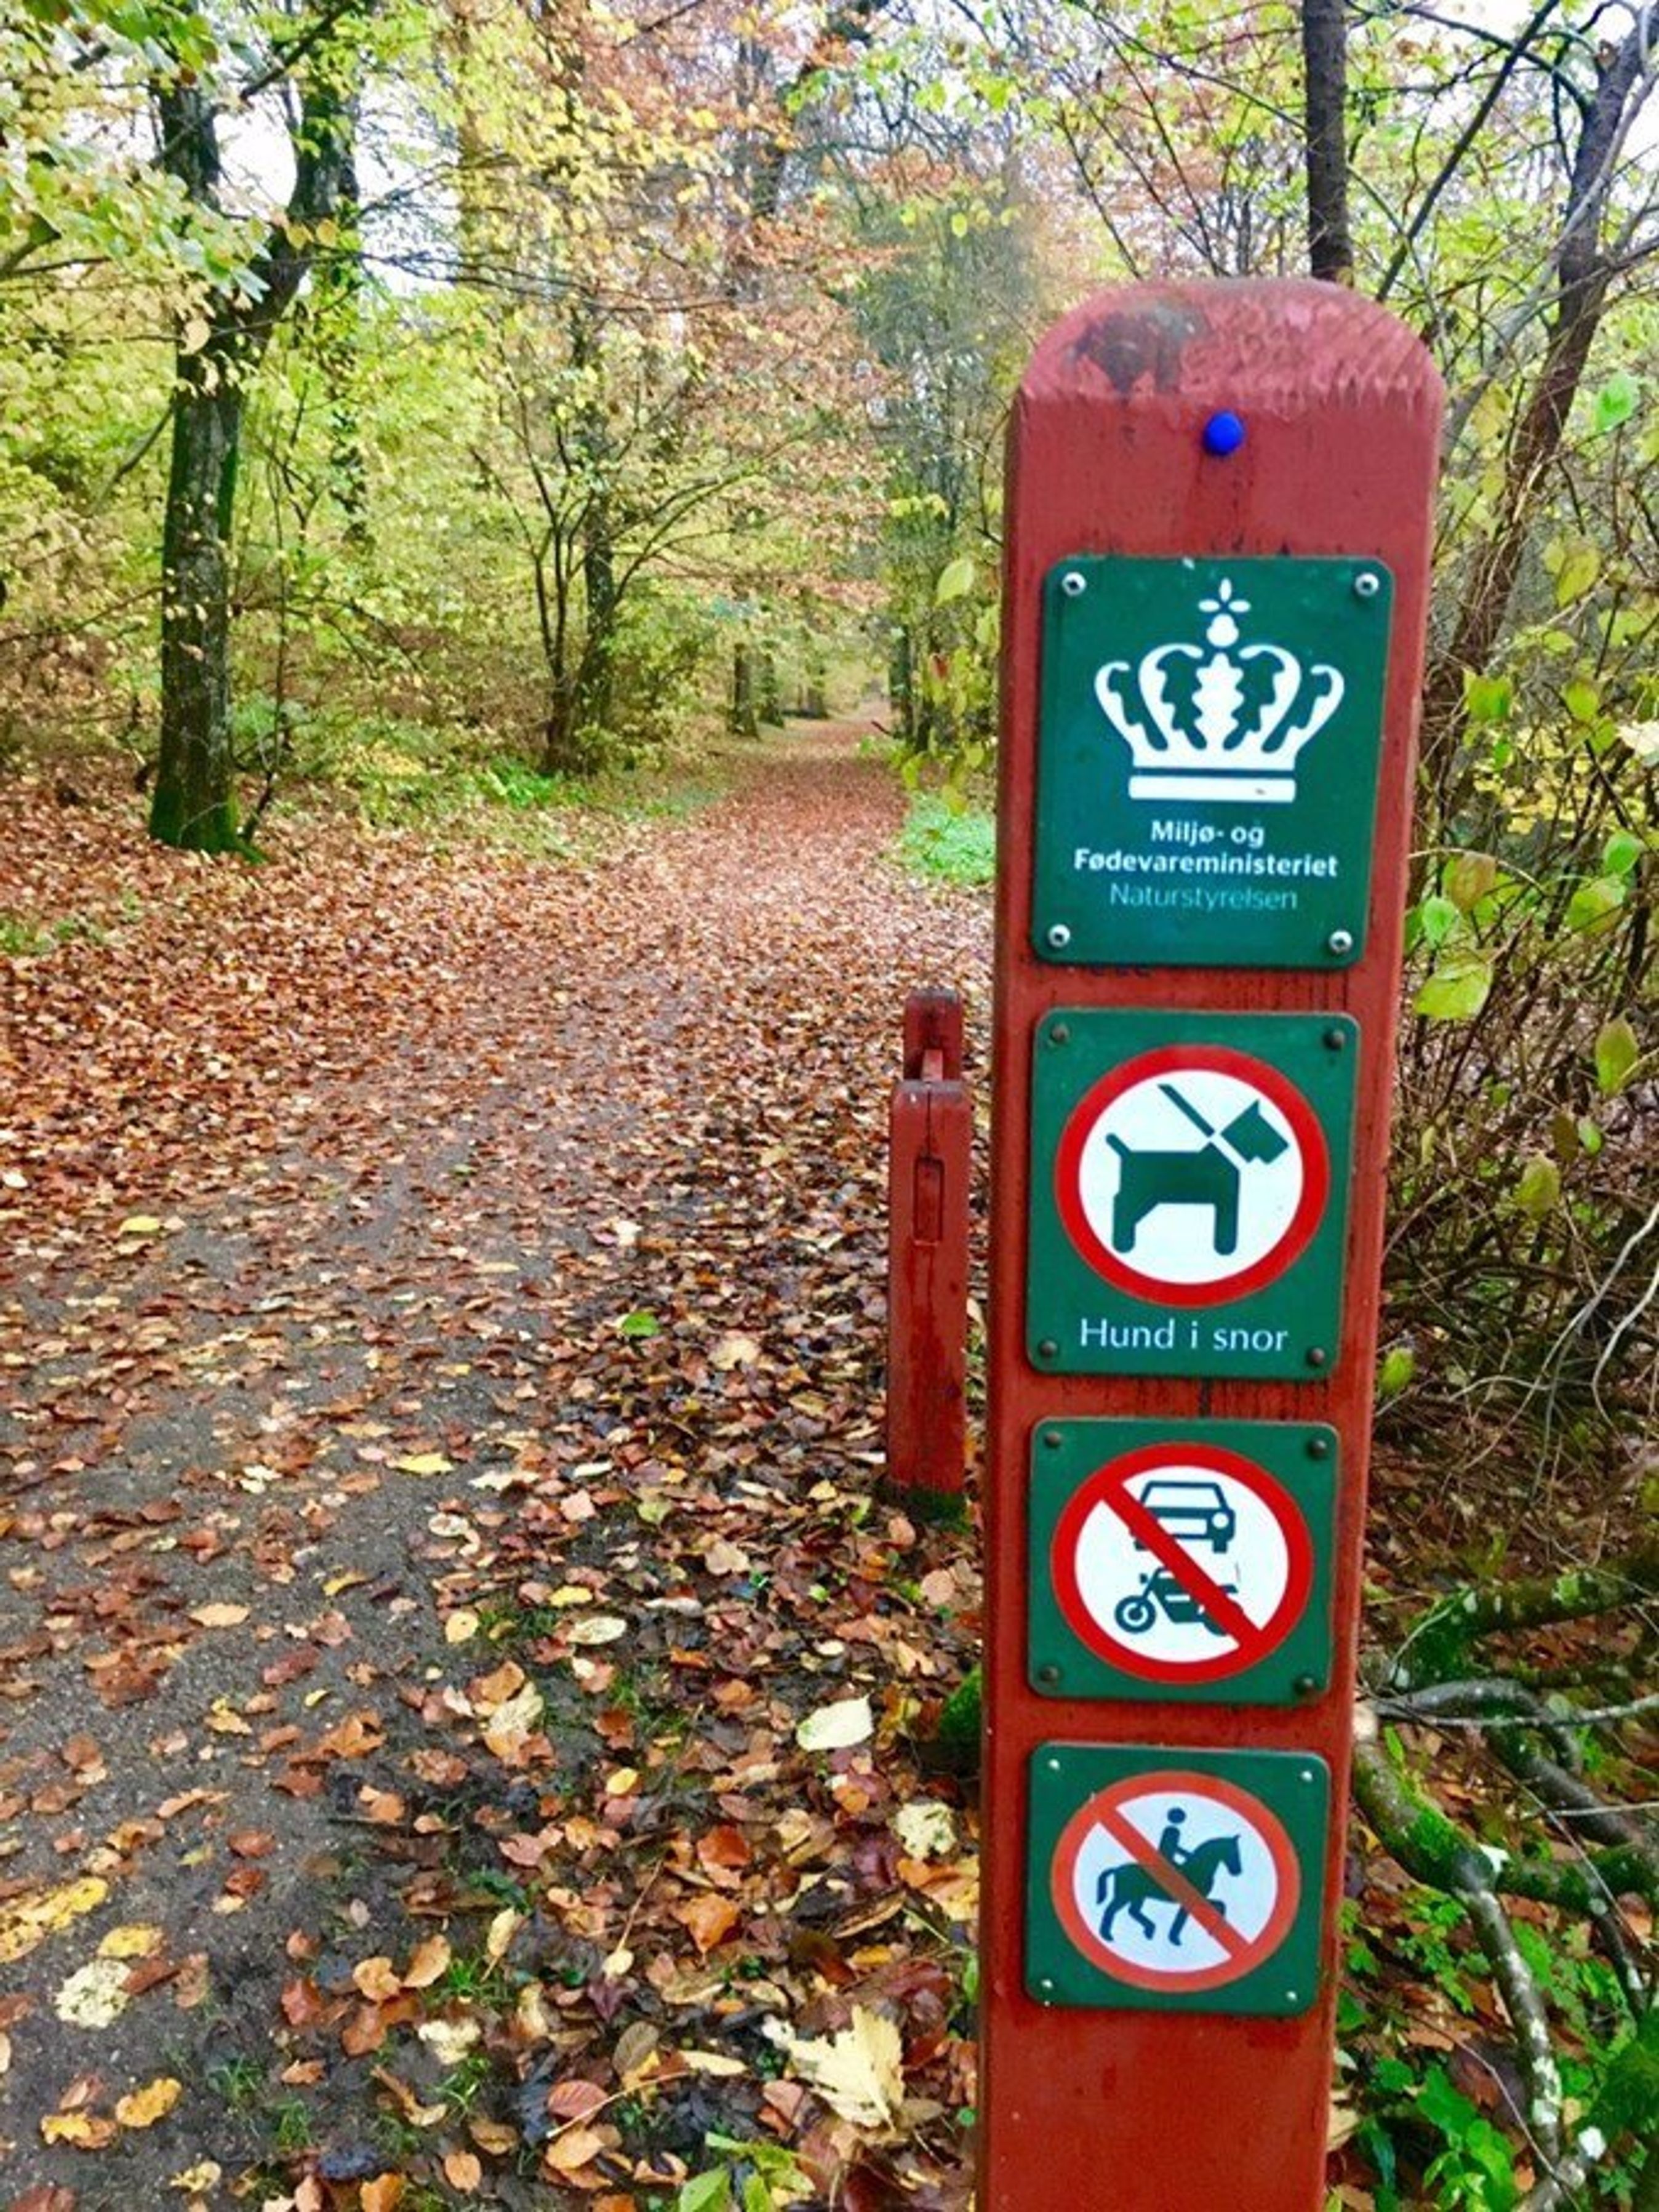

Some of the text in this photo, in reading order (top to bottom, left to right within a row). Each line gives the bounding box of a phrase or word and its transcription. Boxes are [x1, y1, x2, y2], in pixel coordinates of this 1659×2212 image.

[1150, 820, 1265, 849] Miljø- og
[1073, 848, 1338, 878] Fødevareministeriet
[1109, 883, 1298, 912] Naturstyrelsen
[1080, 1318, 1289, 1352] Hund i snor
